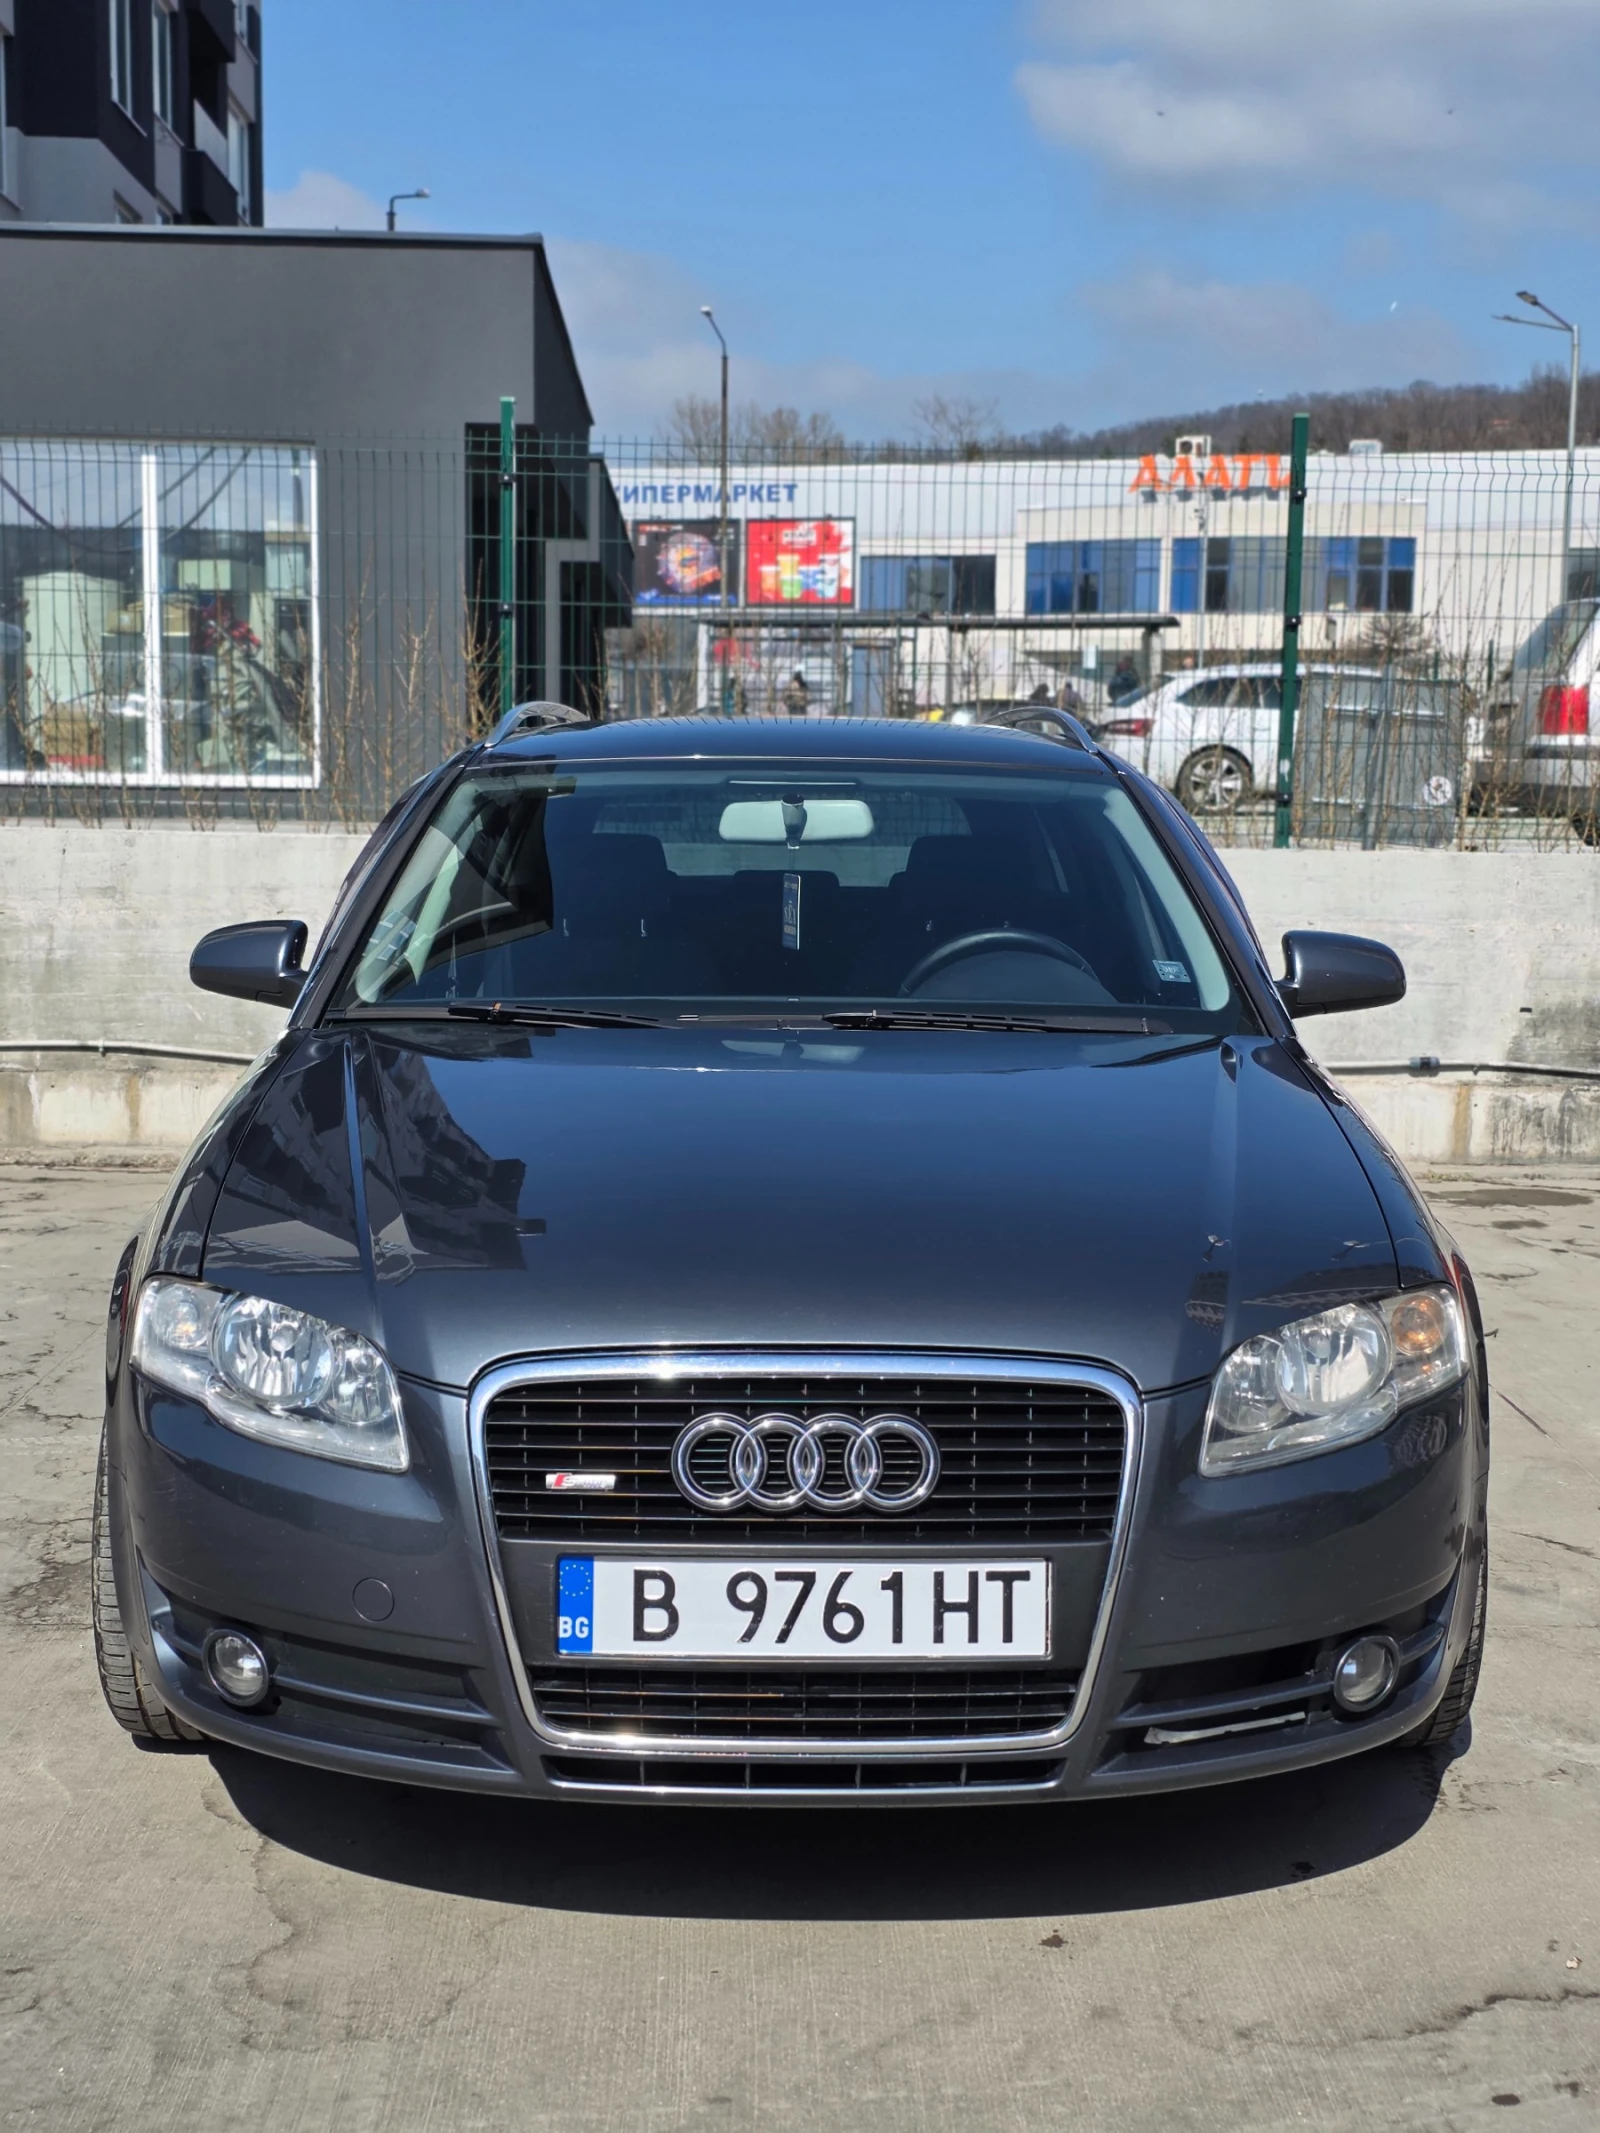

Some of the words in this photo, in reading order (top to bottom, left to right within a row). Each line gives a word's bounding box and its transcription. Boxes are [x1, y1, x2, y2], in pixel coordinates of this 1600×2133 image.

[615, 483, 798, 504] ИПЕРМАРКЕТ
[633, 1568, 680, 1642] B
[558, 1616, 590, 1639] BG
